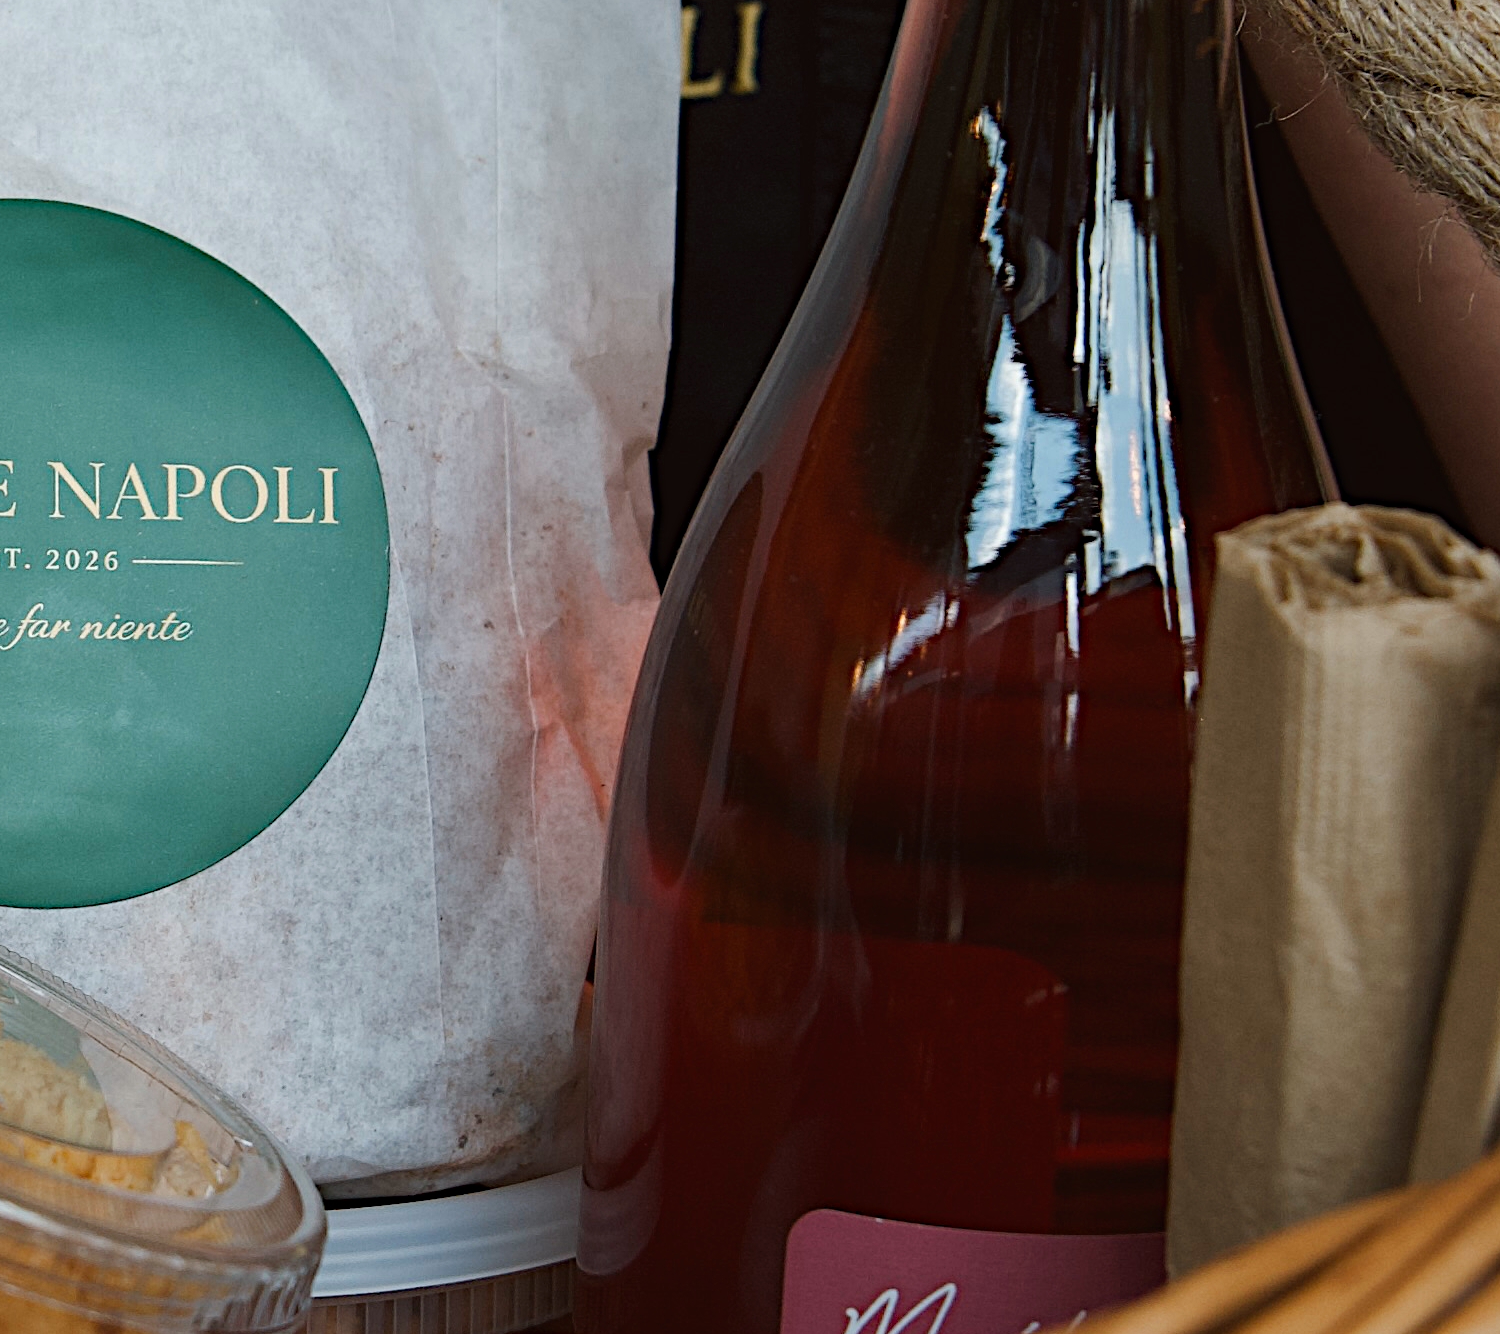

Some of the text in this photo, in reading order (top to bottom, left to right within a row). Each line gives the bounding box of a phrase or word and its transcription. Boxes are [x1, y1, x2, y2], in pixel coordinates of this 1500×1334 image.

[47, 459, 341, 526] NAPOLI
[45, 548, 120, 572] 2026
[78, 611, 194, 642] niente
